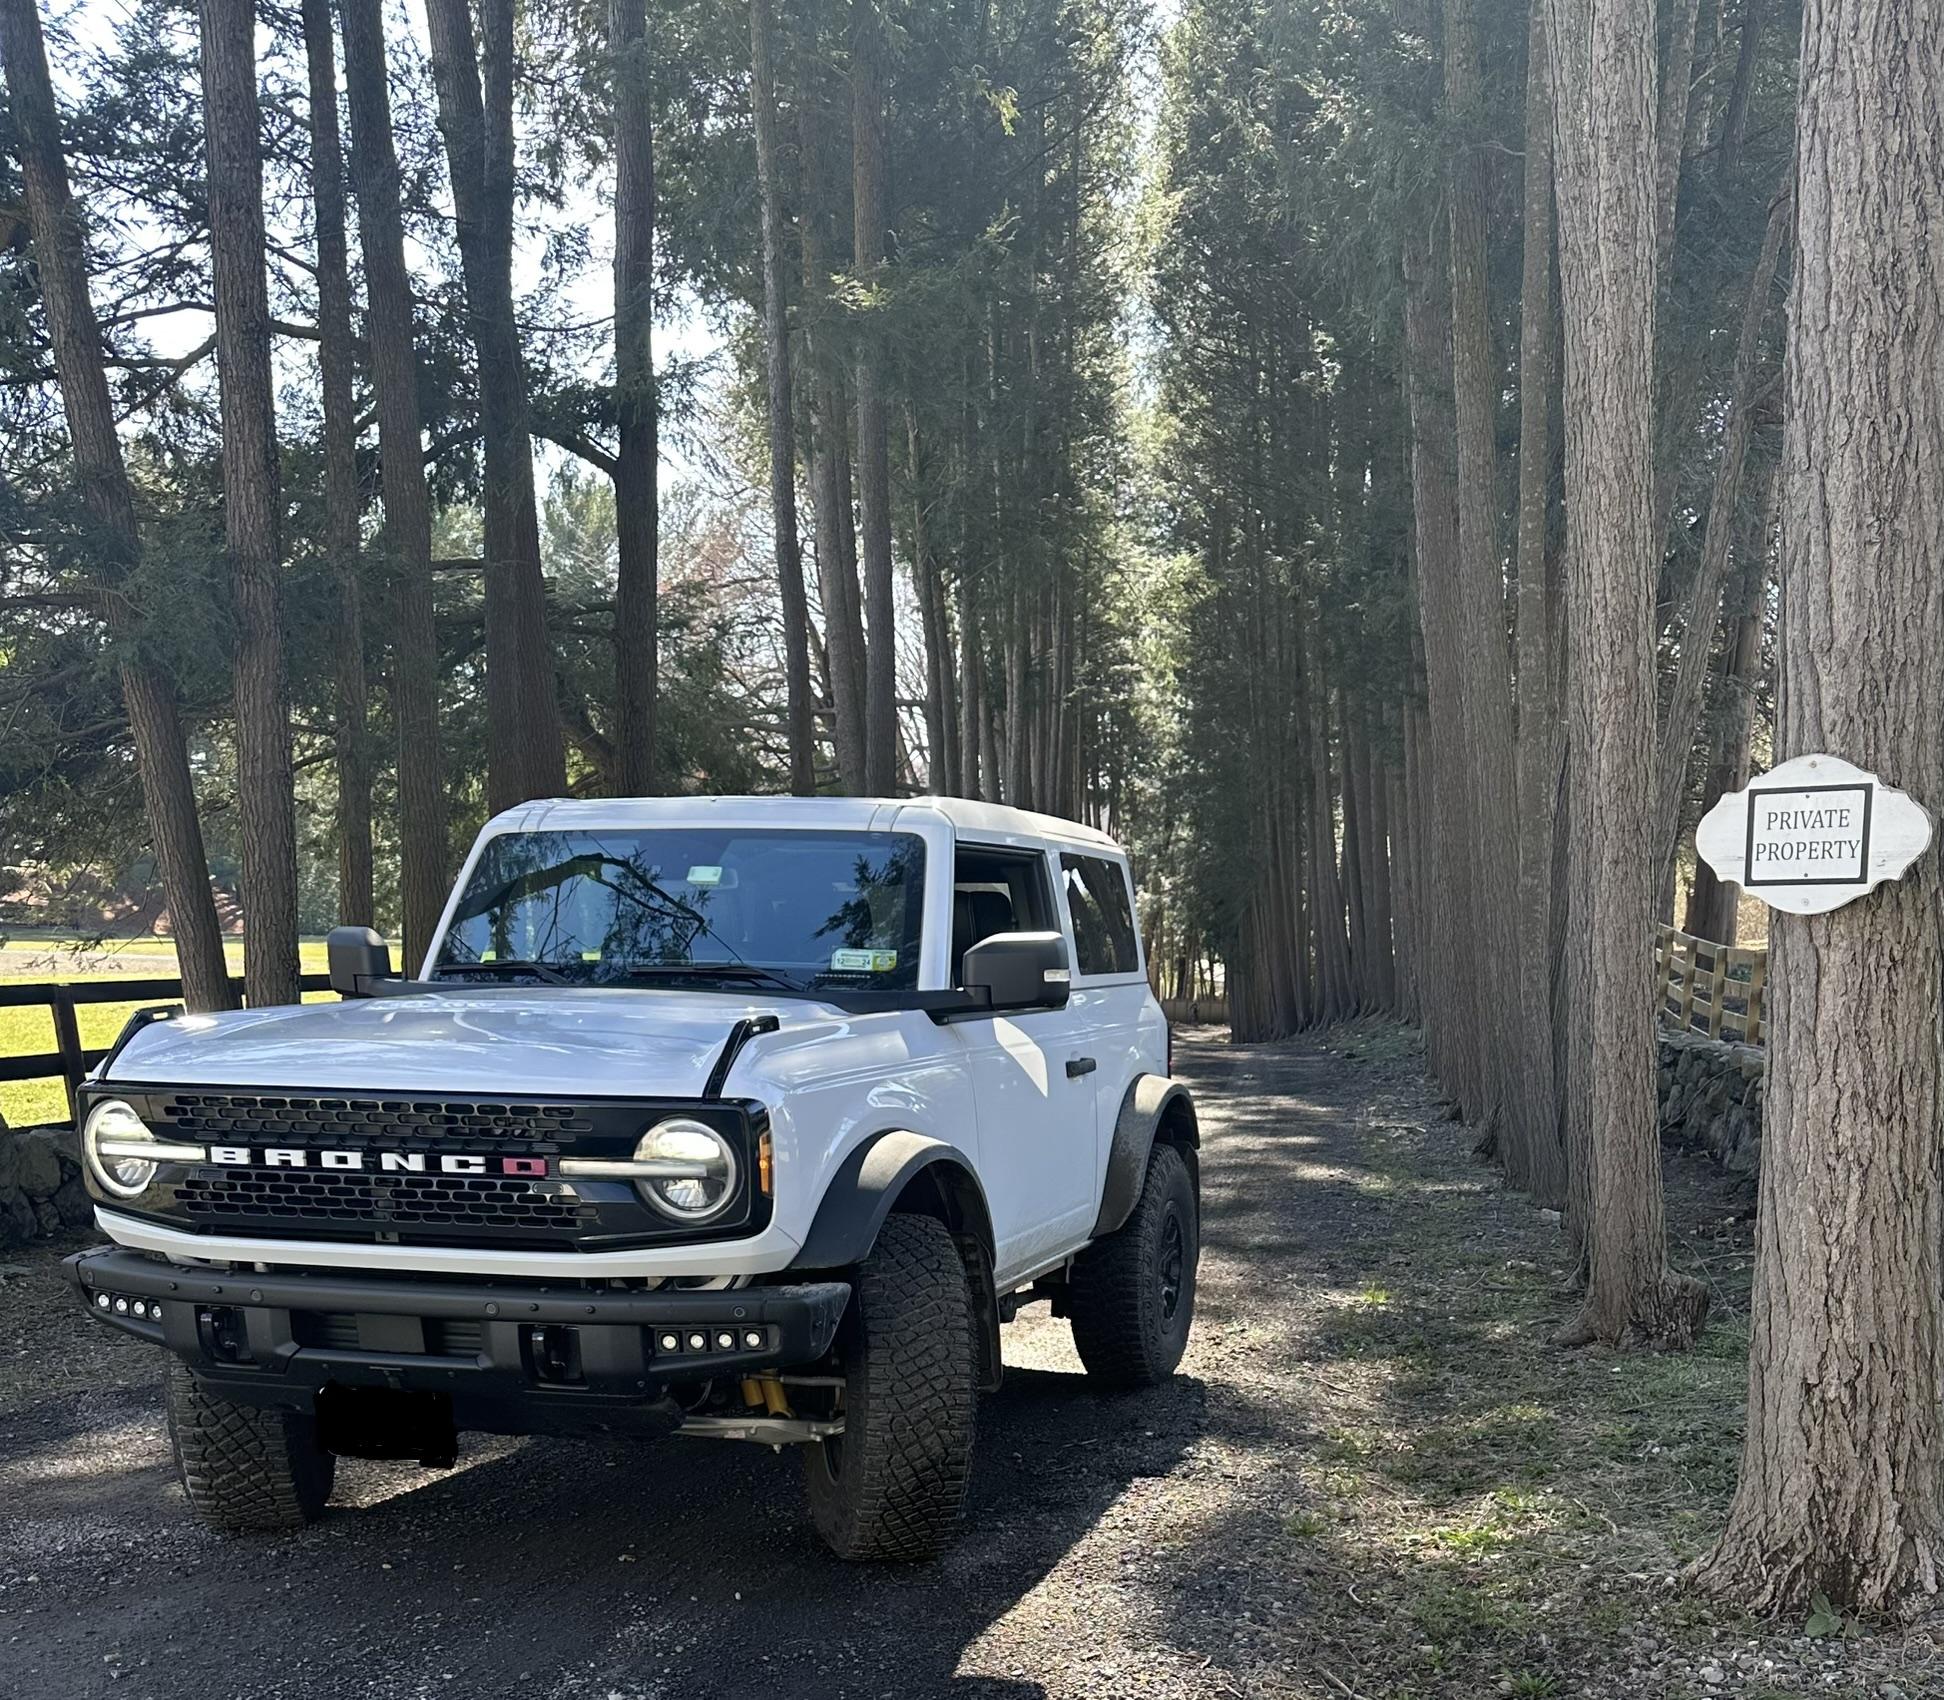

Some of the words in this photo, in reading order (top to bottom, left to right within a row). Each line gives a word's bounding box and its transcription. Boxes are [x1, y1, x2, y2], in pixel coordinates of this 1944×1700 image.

[1766, 808, 1851, 831] PRIVATE
[1755, 839, 1861, 862] PROPERTY
[210, 1145, 547, 1176] BRONCO
